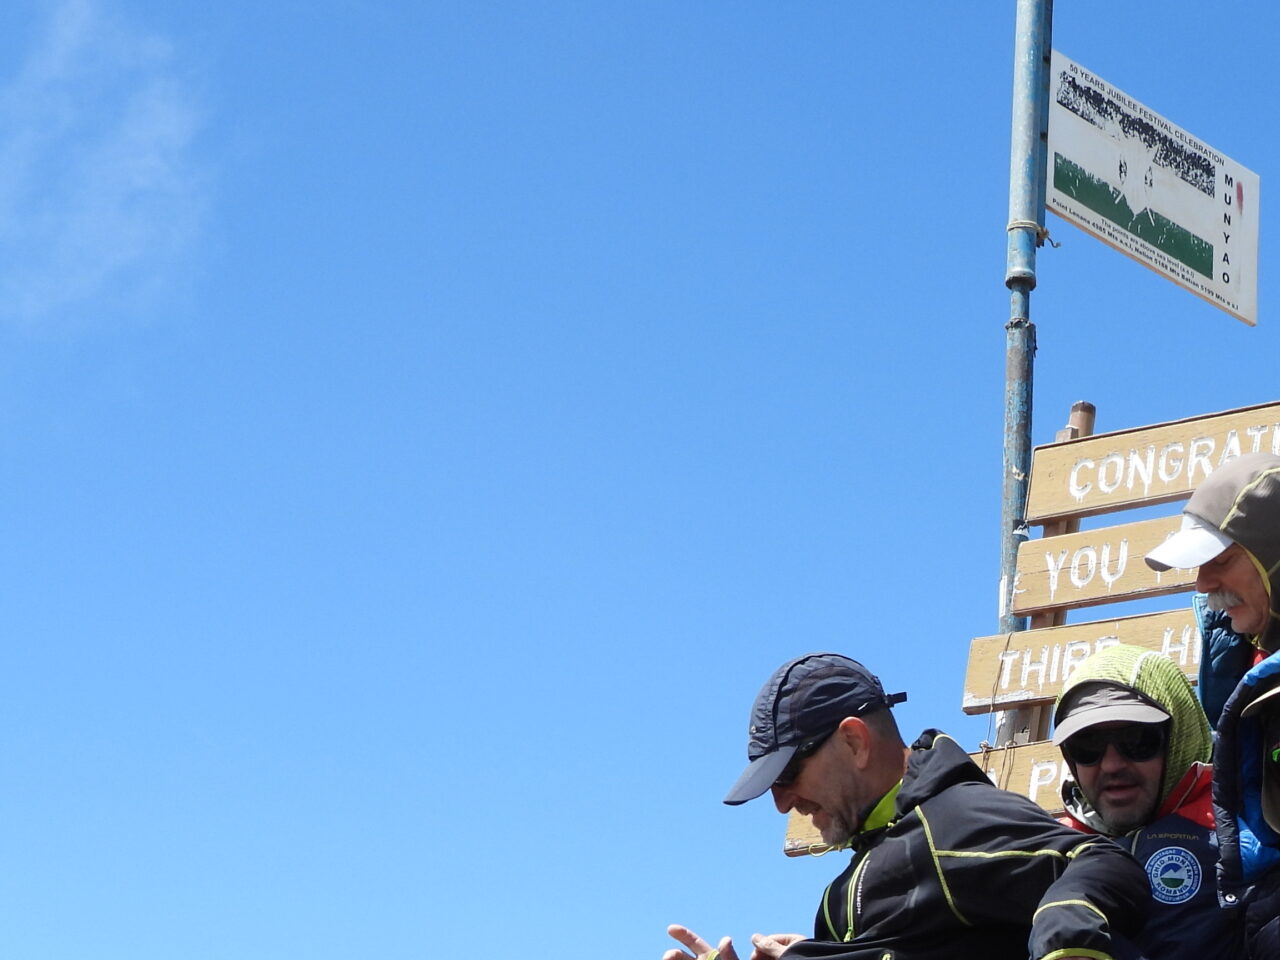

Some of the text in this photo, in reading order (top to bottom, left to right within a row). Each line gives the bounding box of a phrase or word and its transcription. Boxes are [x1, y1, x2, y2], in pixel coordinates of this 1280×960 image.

[1069, 63, 1225, 166] 50 YEARS JUBILEE FESTIVAL CELEBRATION
[1046, 538, 1129, 601] YOU
[999, 636, 1121, 691] THIR
